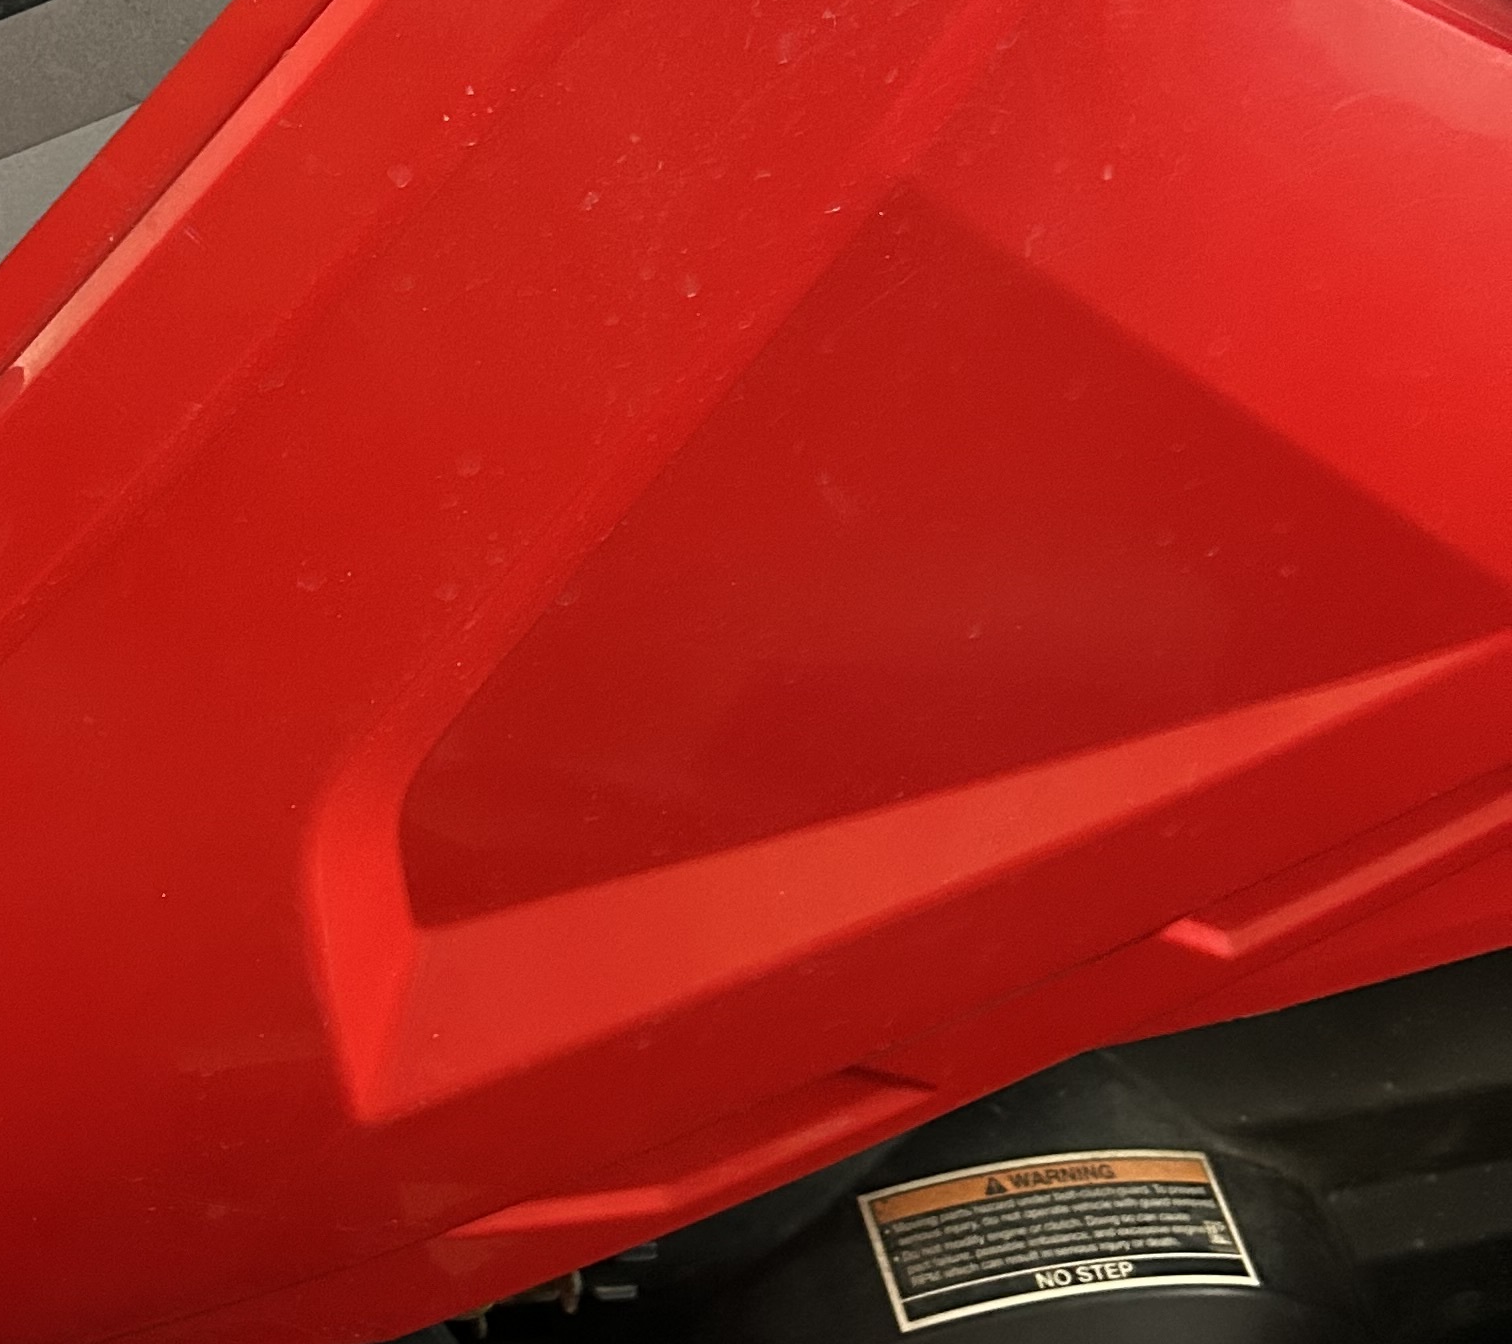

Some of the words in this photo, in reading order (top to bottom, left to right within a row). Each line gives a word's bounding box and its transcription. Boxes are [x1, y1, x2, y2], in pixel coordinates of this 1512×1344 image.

[1008, 1164, 1117, 1188] WARNING
[1035, 1268, 1073, 1290] NO
[1075, 1260, 1135, 1283] STEP
